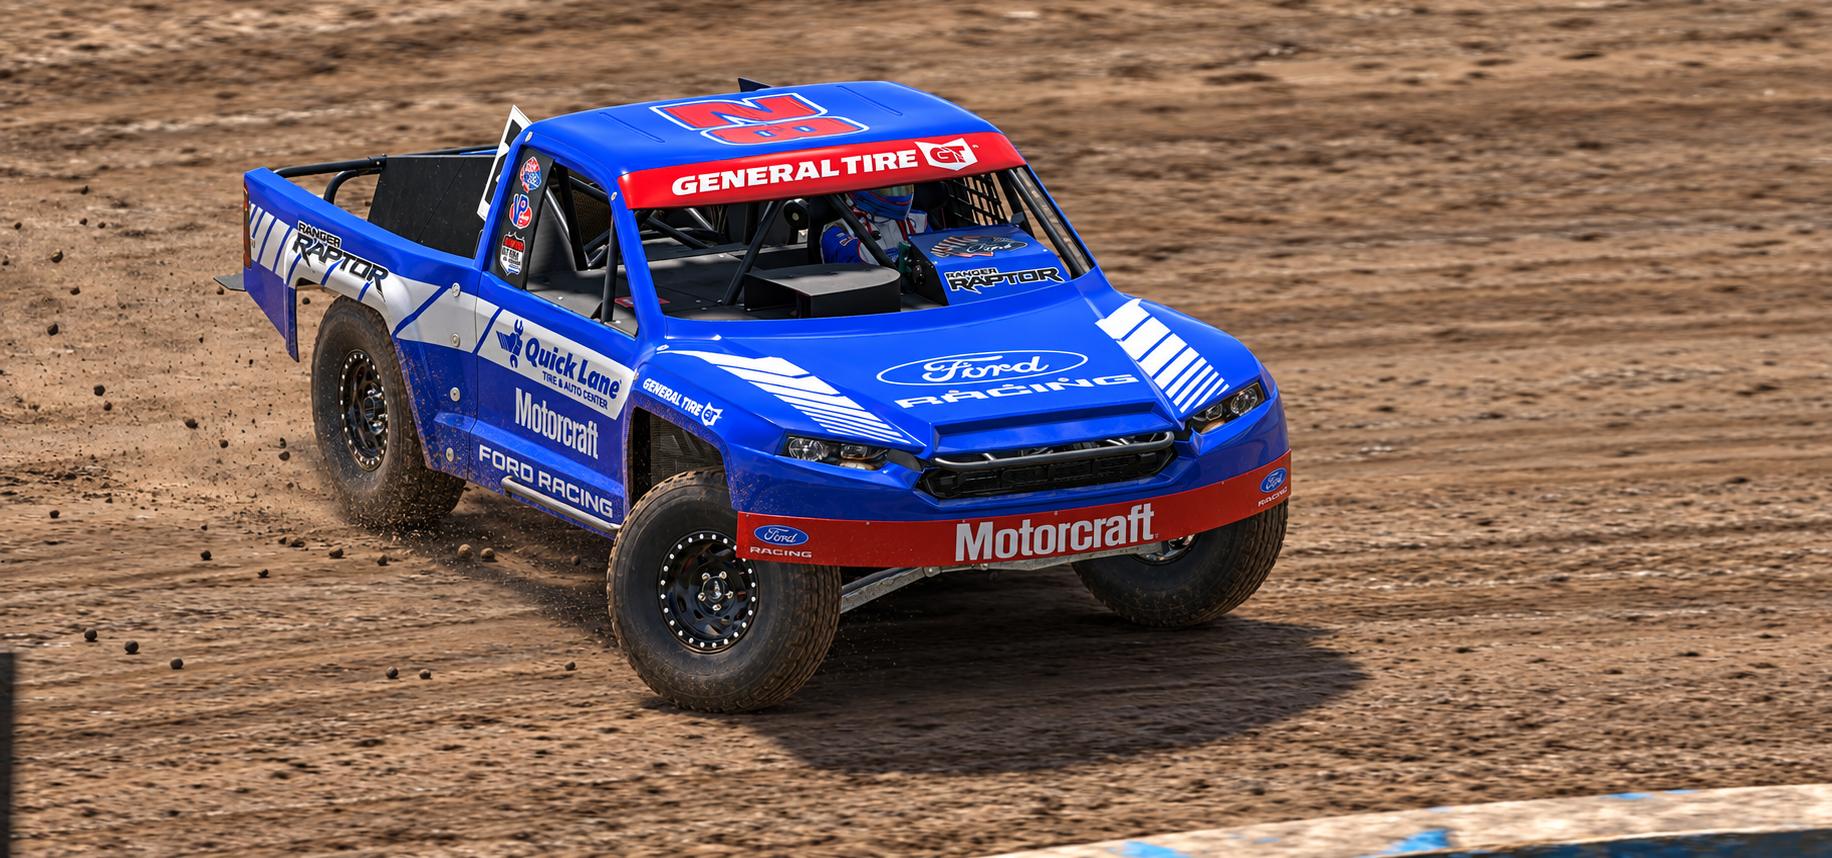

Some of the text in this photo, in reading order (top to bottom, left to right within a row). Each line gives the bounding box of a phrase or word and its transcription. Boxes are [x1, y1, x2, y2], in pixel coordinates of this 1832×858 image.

[671, 146, 966, 196] GENERAL TIRE GT
[298, 221, 341, 248] RANGER
[292, 233, 389, 302] RAPTOR
[945, 268, 998, 278] RANGER
[948, 268, 1064, 294] RAPTOR
[525, 337, 620, 400] Quick Lane
[922, 355, 1049, 382] Ford
[542, 370, 558, 386] TIRE
[564, 381, 582, 397] AUTO
[583, 389, 608, 410] CENTER
[643, 378, 681, 406] GENERAL
[680, 399, 703, 417] TIRE
[894, 374, 1139, 409] RACING
[515, 387, 599, 460] Motorcraft
[479, 444, 613, 519] FORD RACING
[764, 527, 798, 543] Ford
[955, 503, 1155, 561] Motorcraft
[749, 546, 812, 558] RACING
